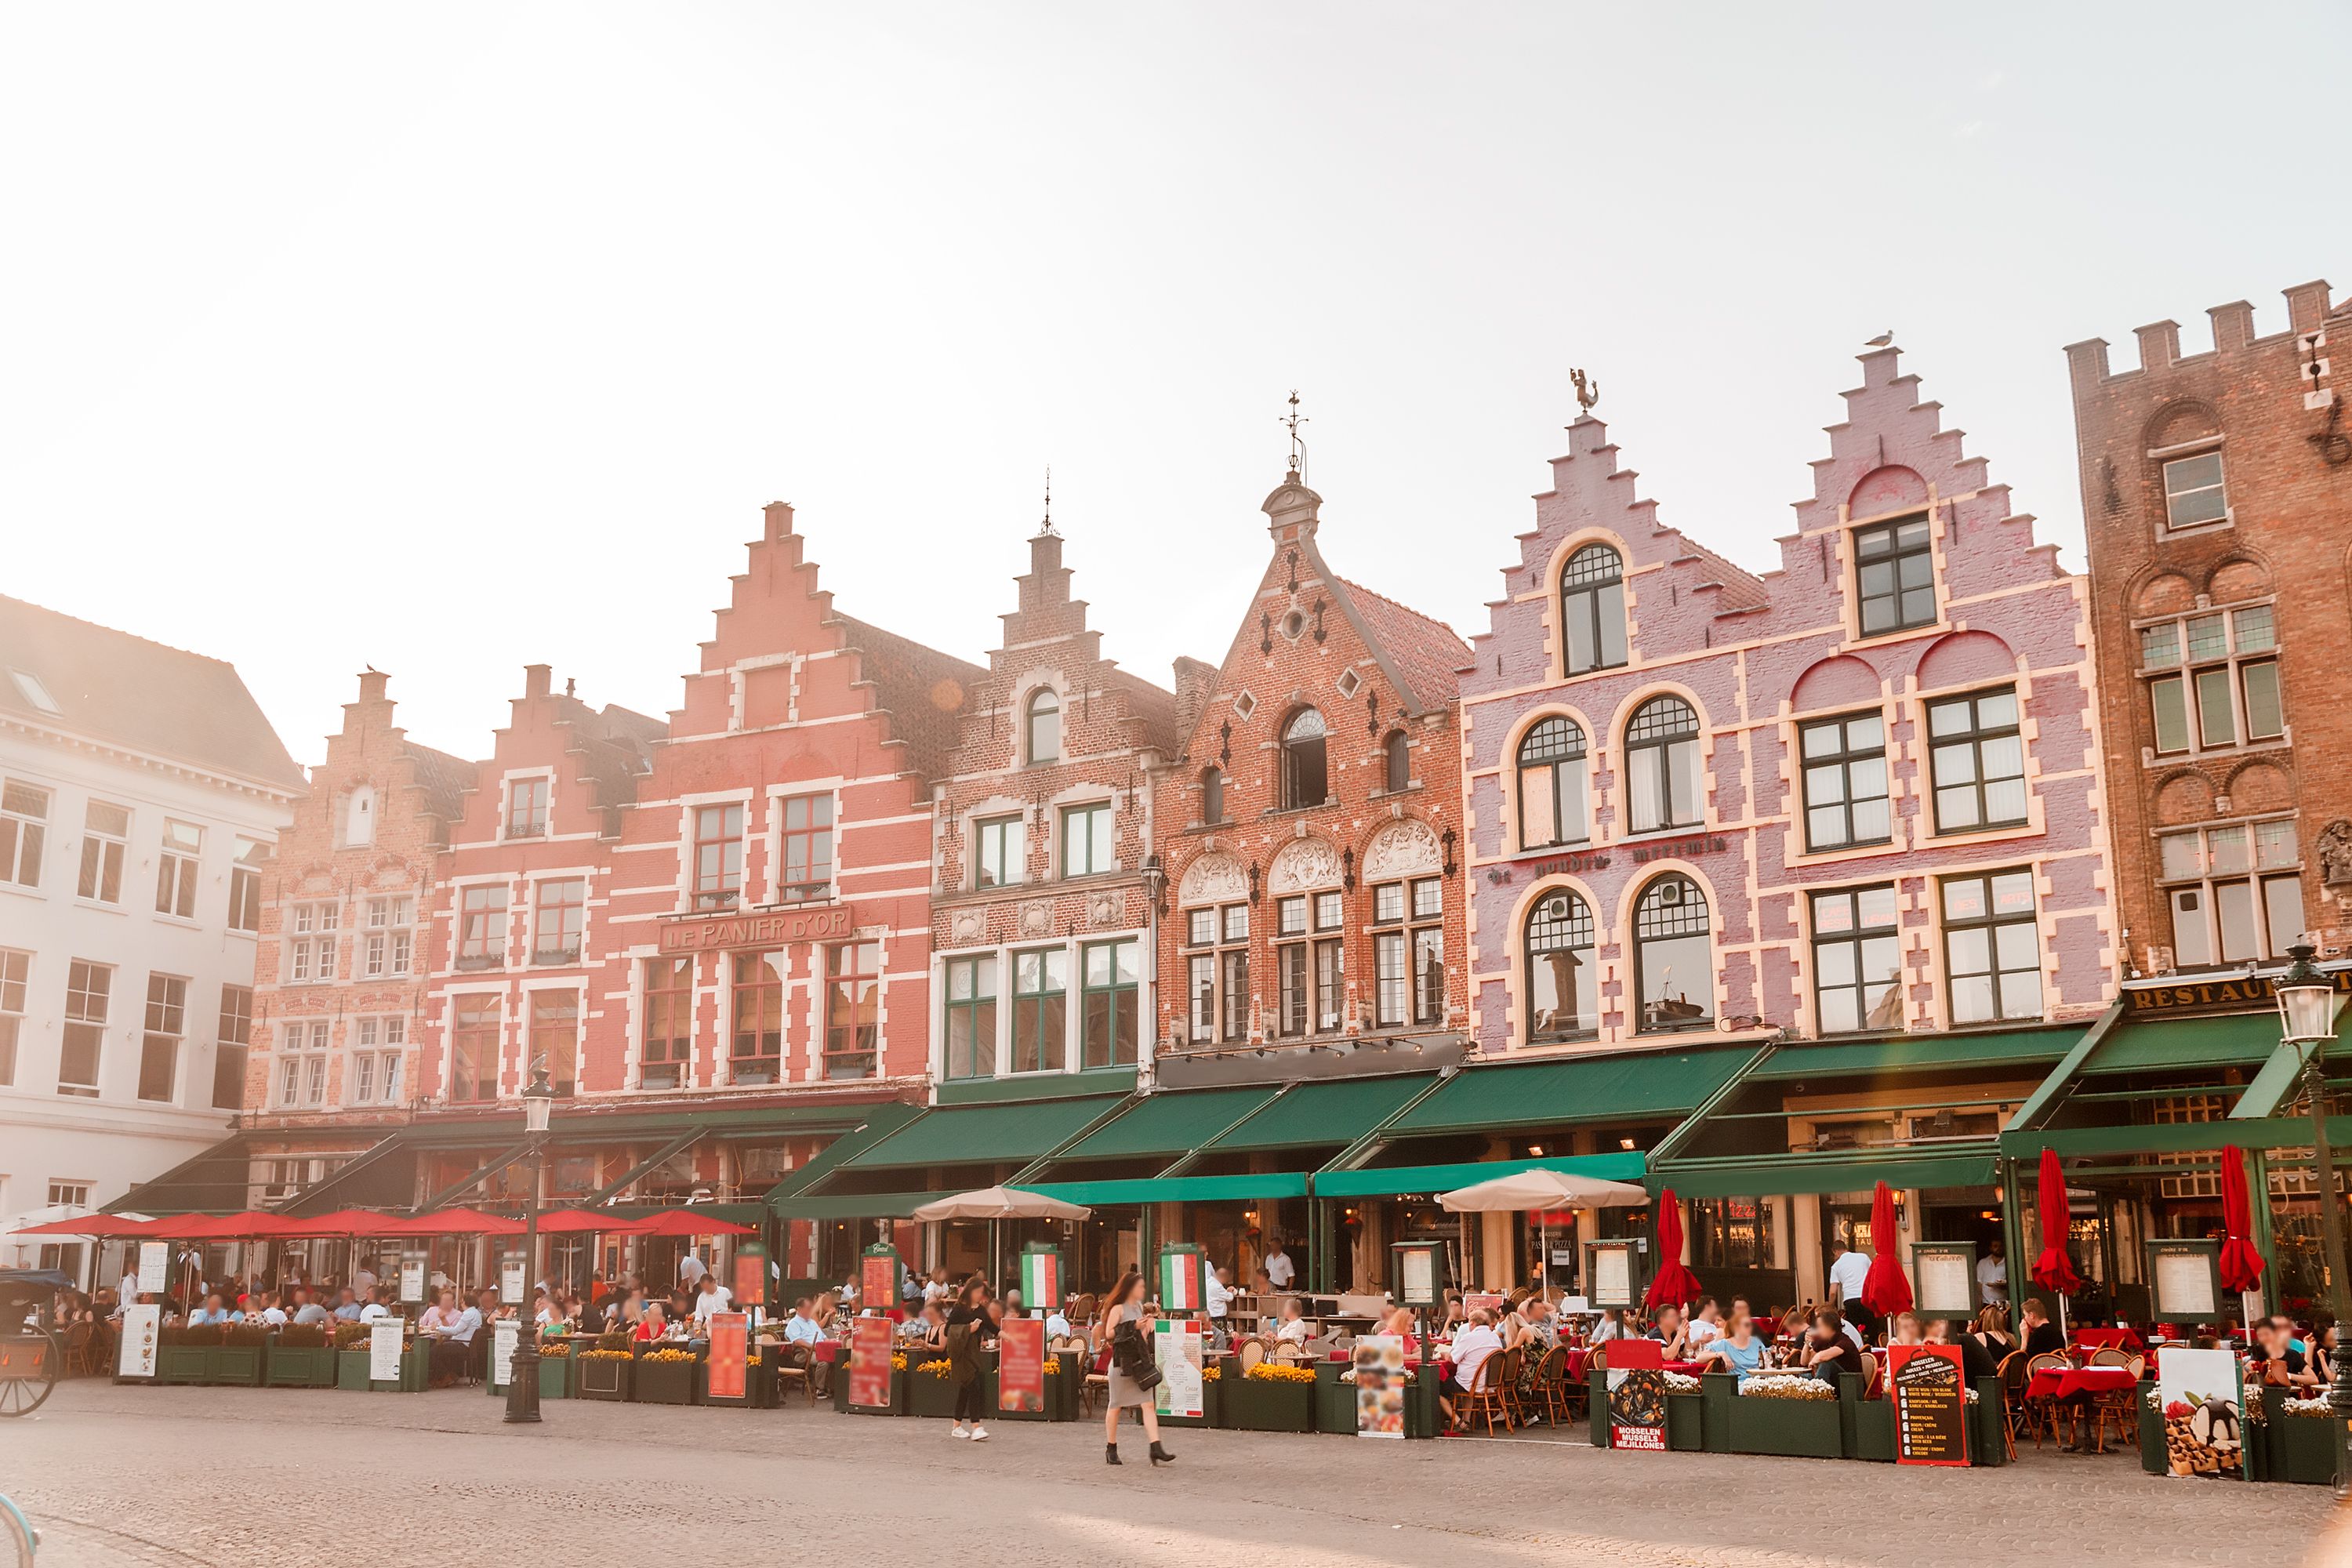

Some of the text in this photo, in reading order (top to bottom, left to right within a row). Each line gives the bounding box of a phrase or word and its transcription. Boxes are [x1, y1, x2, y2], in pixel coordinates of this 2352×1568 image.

[1633, 833, 1726, 862] meermin
[668, 912, 846, 949] LE PANIER D'OR
[1911, 1356, 1935, 1367] MOSSELEN
[1618, 1426, 1661, 1436] MOSSELEN
[1622, 1434, 1658, 1443] MUSSELS
[1616, 1439, 1665, 1450] MEJILLONES
